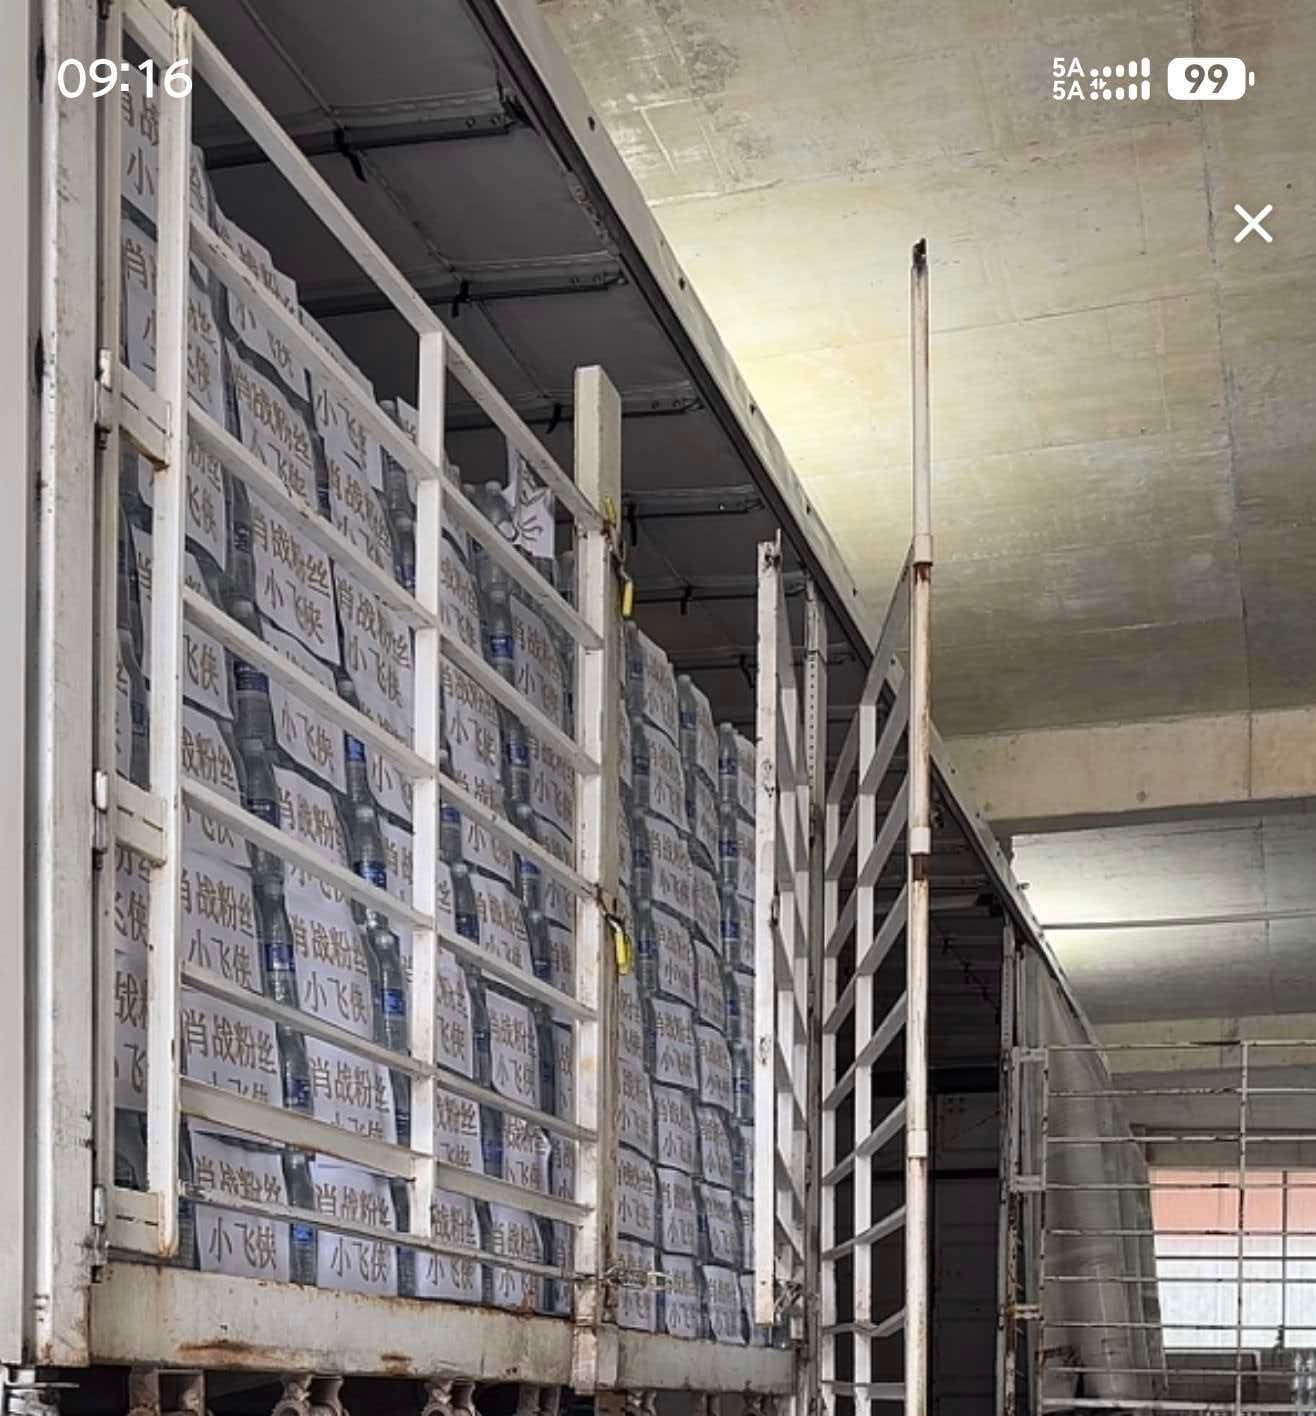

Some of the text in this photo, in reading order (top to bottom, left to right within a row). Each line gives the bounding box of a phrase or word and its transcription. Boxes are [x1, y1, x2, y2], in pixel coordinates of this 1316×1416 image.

[254, 511, 331, 600] 肖战粉丝
[264, 567, 325, 645] 小飞侠
[336, 577, 412, 670] 肖战粉丝
[183, 633, 220, 697] 飞侠
[351, 634, 404, 709] 小飞侠
[281, 699, 336, 774] 小飞侠
[181, 867, 255, 939] 肖战粉丝
[188, 928, 253, 991] 小飞侠
[290, 913, 368, 977] 肖战粉丝
[304, 970, 368, 1026] 小飞侠
[184, 1008, 277, 1075] 肖战粉丝
[310, 1055, 391, 1114] 肖战粉丝
[314, 1182, 393, 1229] 肖战粉丝
[209, 1215, 278, 1271] 小飞侠
[329, 1237, 389, 1283] 小飞侠
